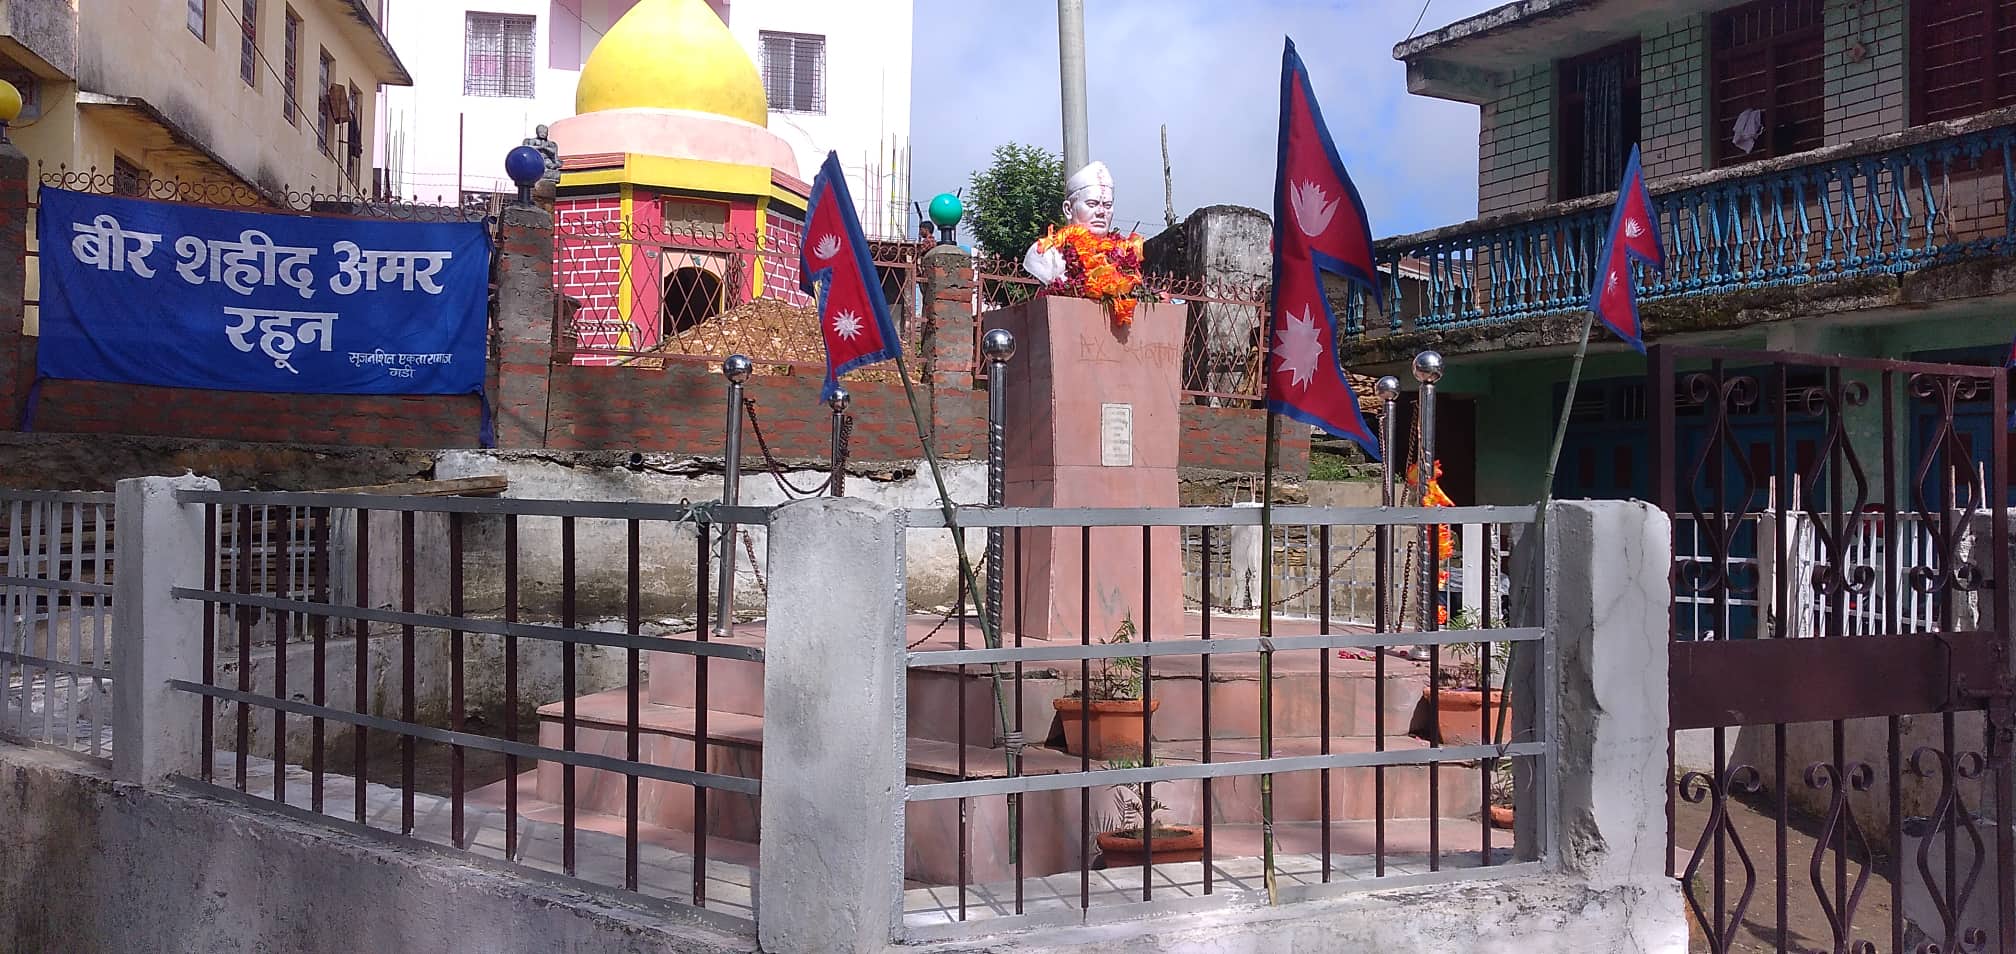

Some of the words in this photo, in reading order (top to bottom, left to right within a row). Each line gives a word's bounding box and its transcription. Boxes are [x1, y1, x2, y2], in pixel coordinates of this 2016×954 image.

[72, 215, 161, 278] बीर
[175, 230, 317, 298] शहीद
[329, 241, 452, 294] अमर
[224, 307, 338, 374] रहून
